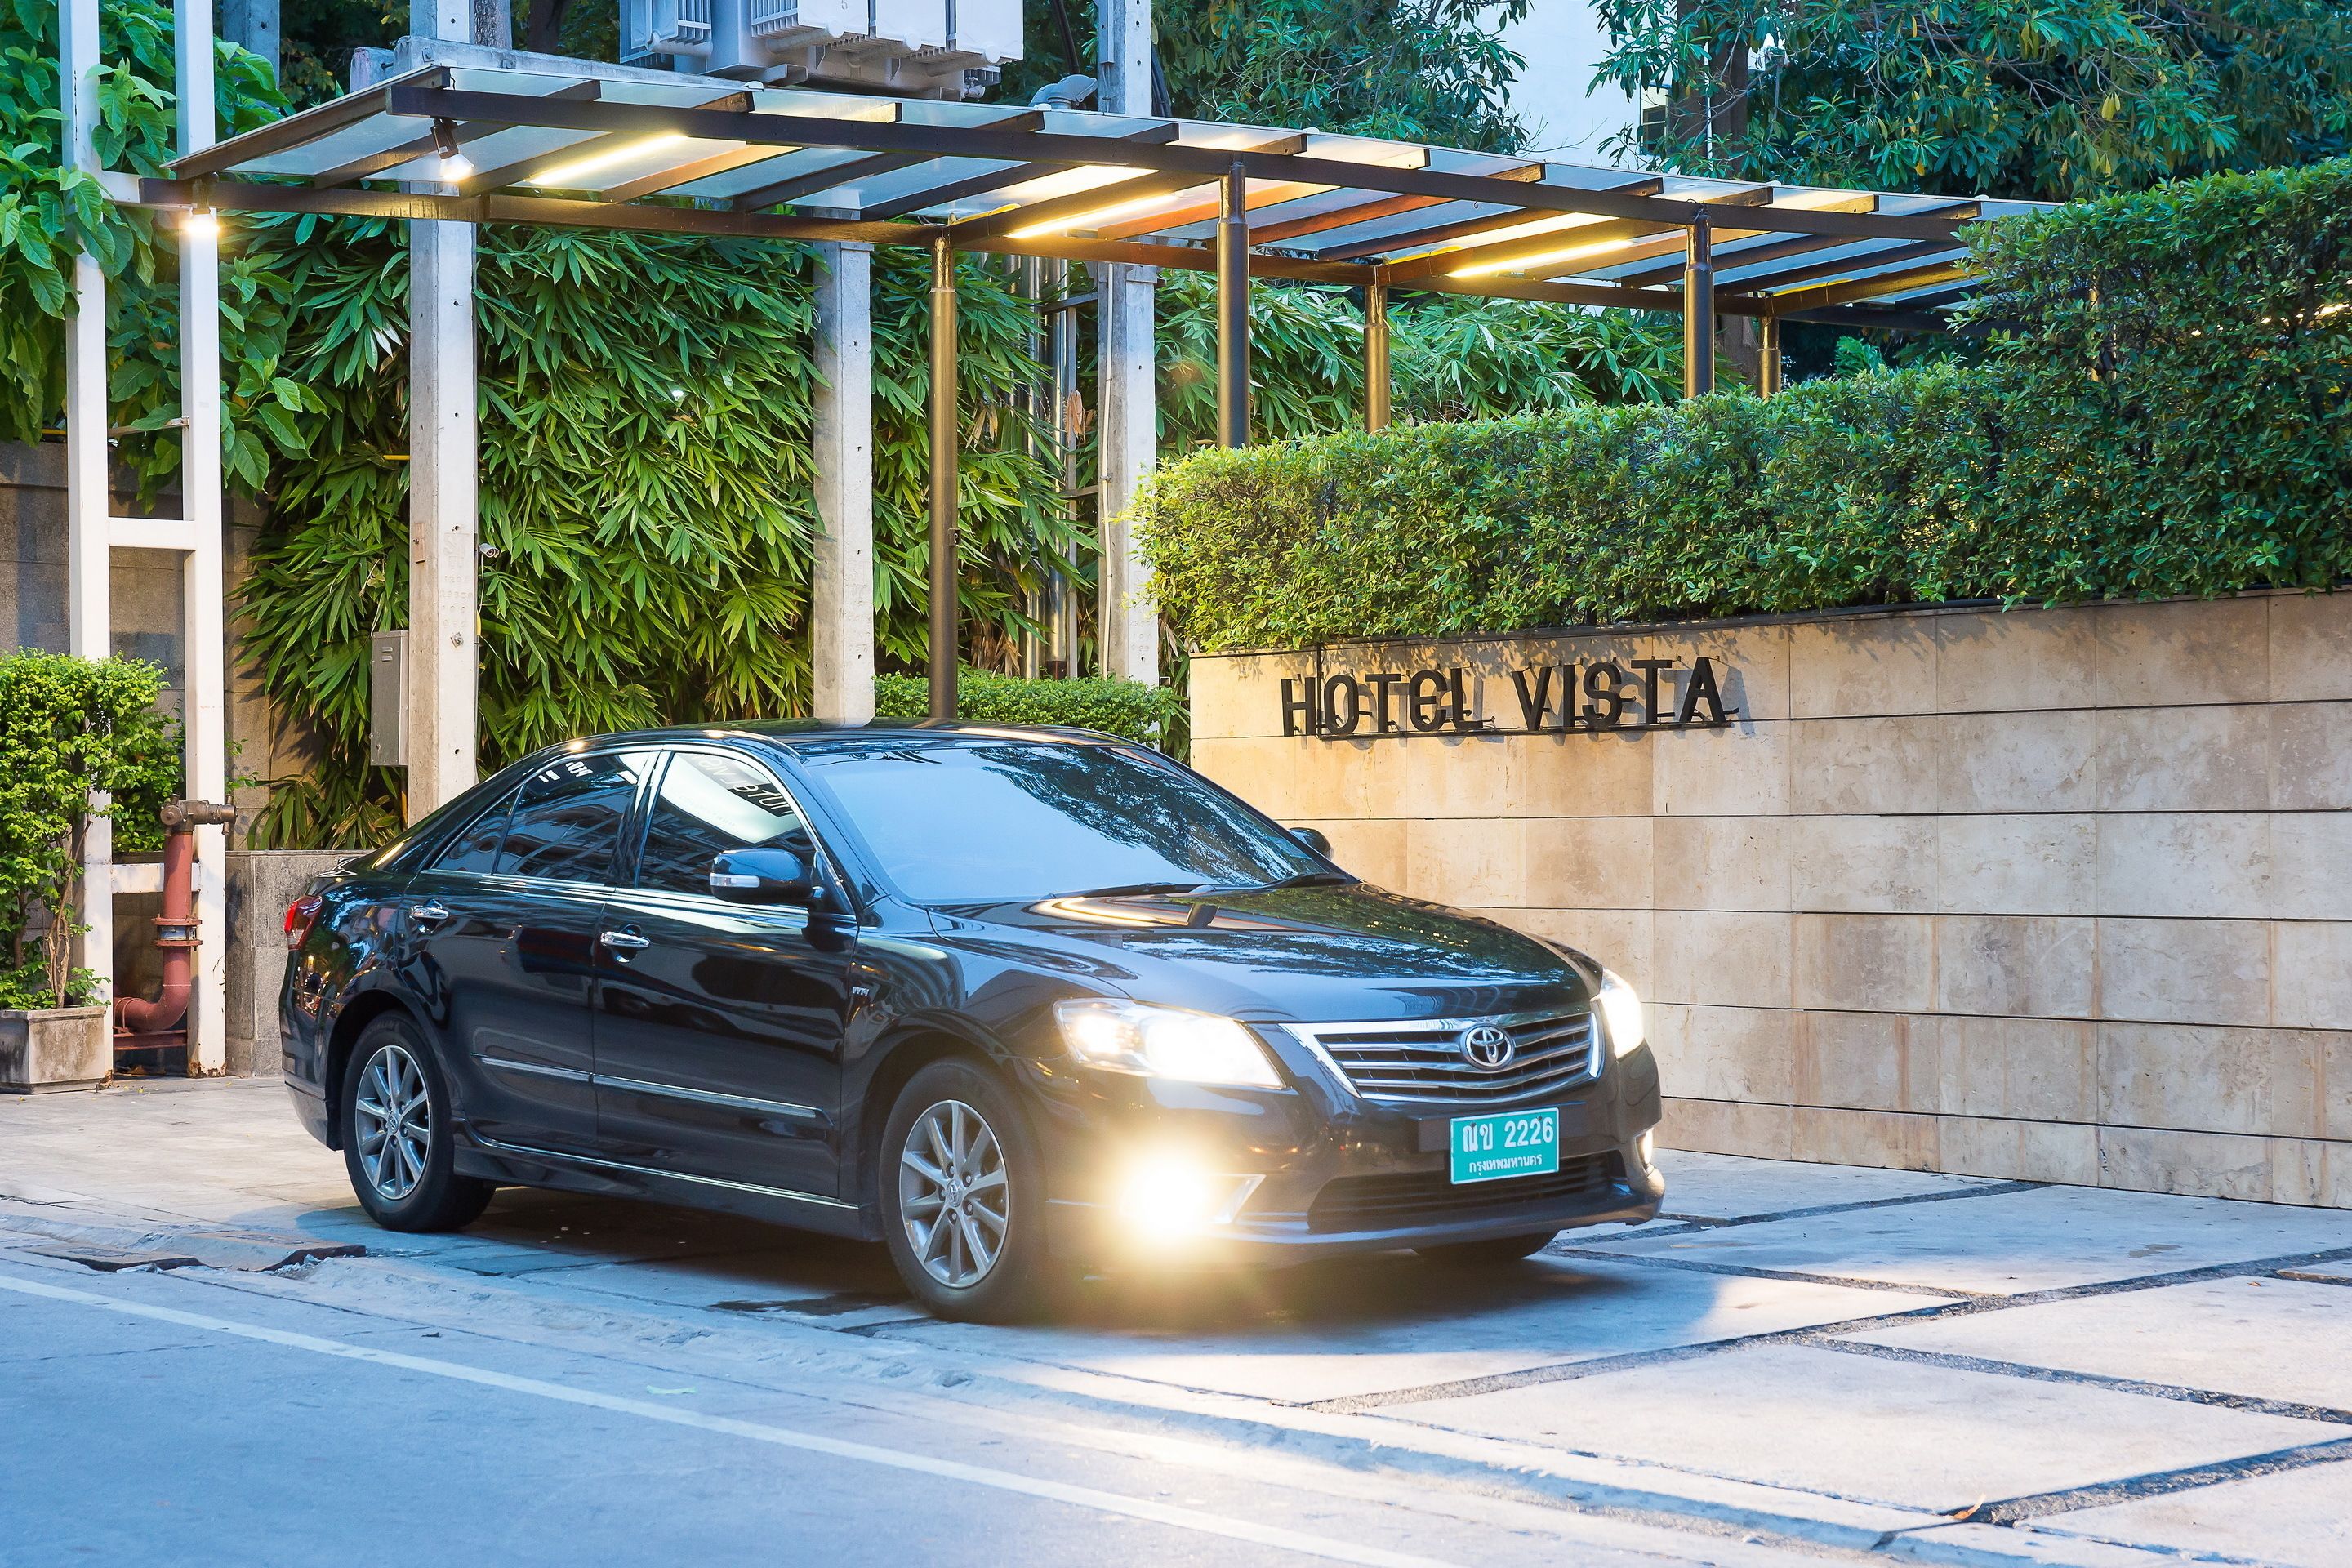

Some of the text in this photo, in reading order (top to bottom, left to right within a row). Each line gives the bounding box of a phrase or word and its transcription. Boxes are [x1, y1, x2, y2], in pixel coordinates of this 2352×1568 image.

[1281, 657, 1726, 737] HOTEL VISTA
[1504, 1116, 1554, 1148] 2226
[1469, 1153, 1543, 1176] กรุงเทพมหานคร
